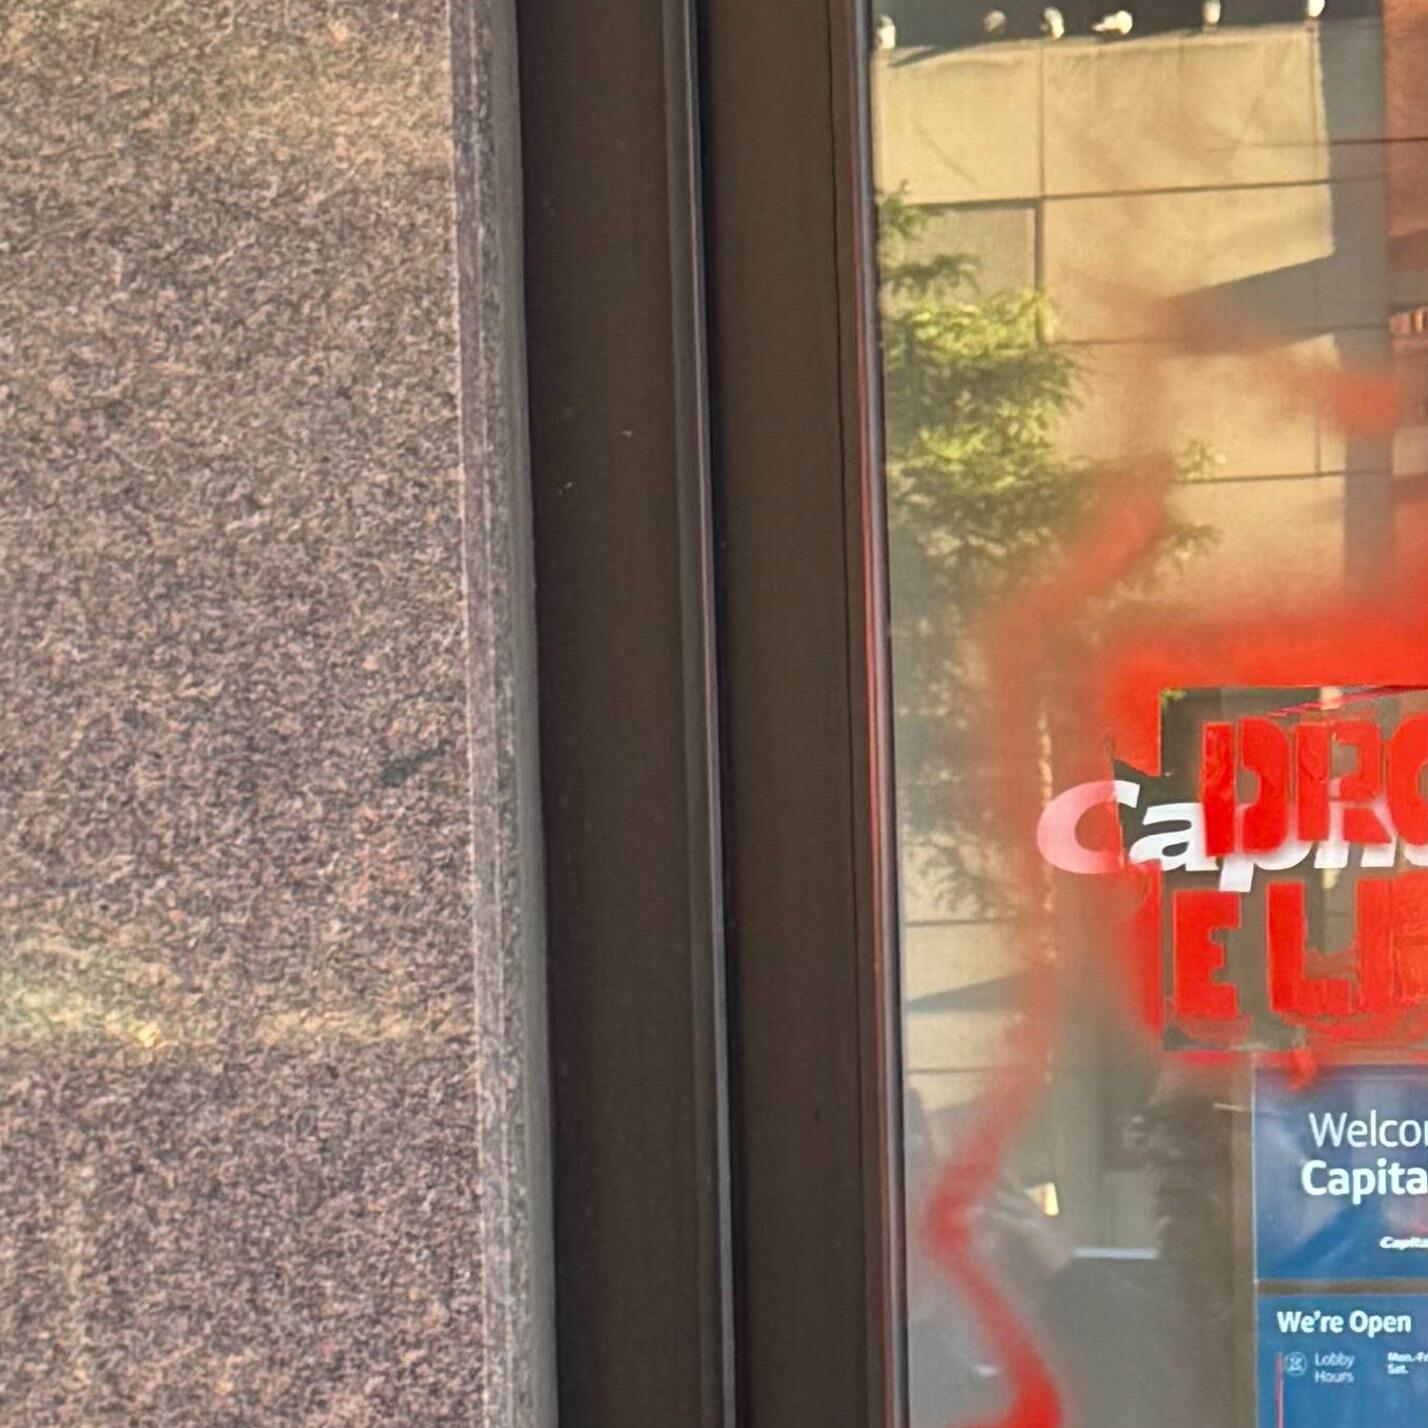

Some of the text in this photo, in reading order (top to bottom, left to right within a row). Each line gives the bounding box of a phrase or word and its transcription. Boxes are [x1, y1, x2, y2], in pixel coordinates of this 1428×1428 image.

[1276, 1310, 1412, 1339] We're Open
[1315, 1352, 1355, 1370] Lobby
